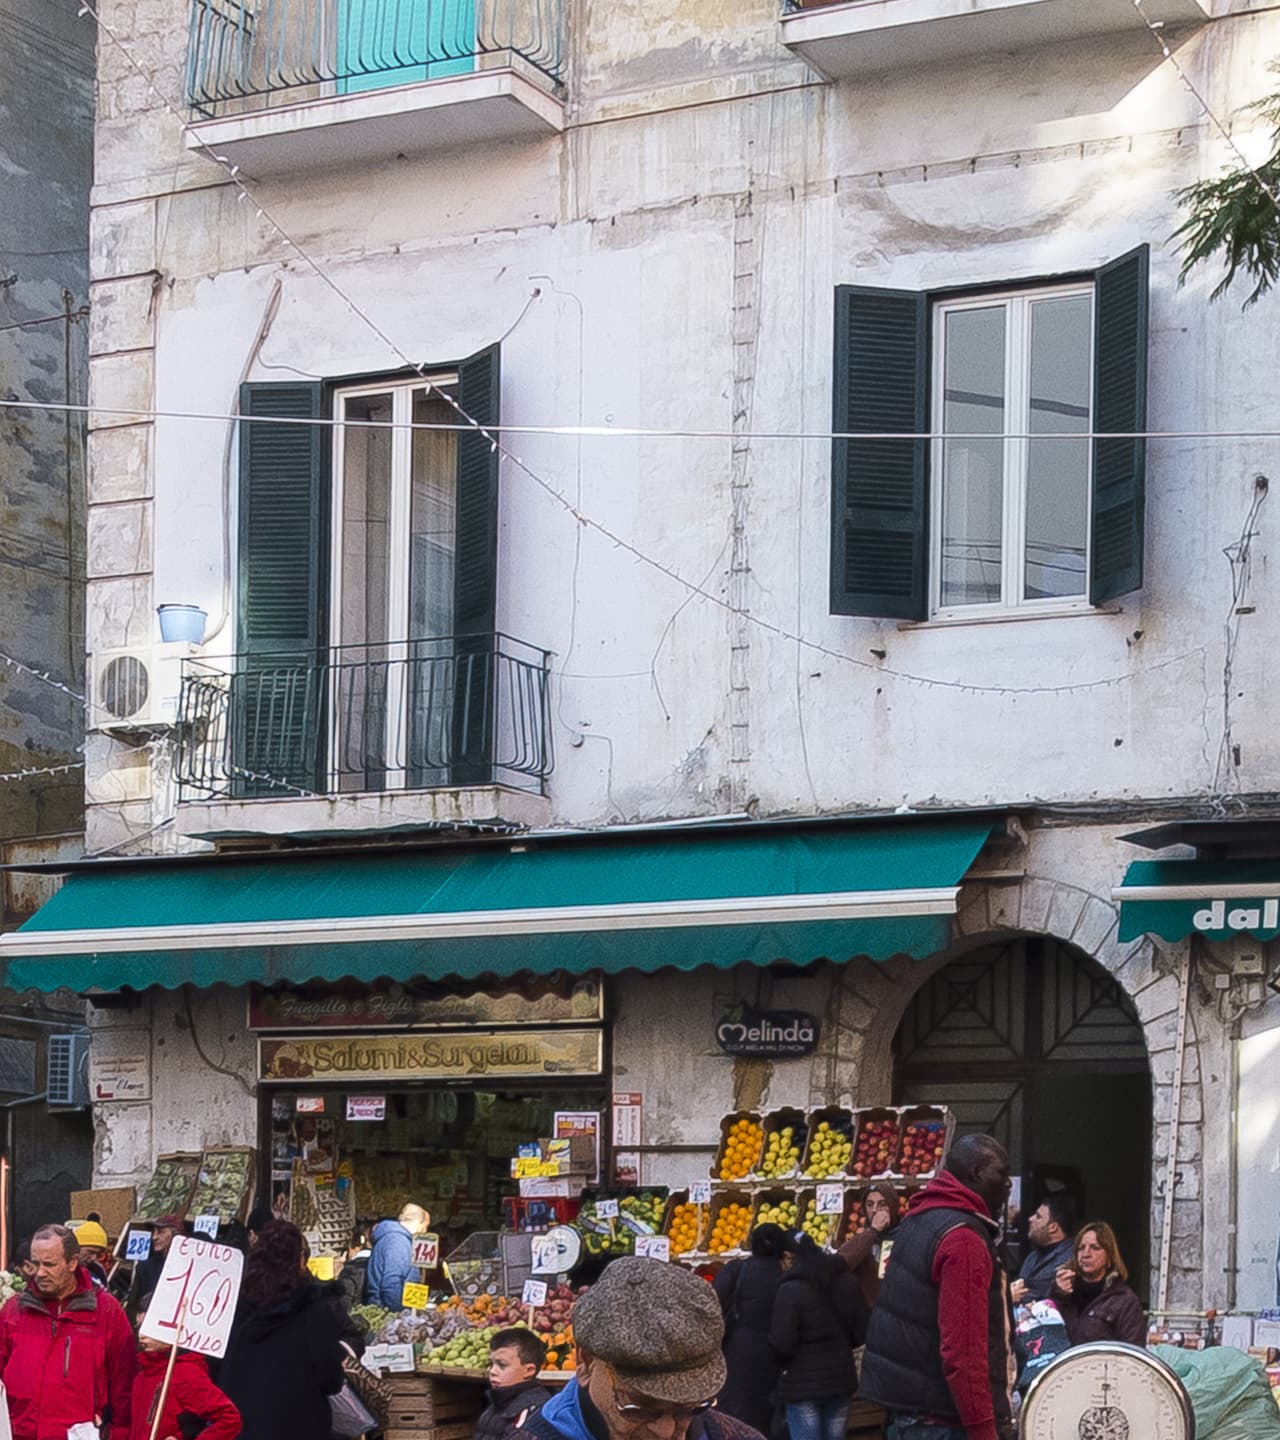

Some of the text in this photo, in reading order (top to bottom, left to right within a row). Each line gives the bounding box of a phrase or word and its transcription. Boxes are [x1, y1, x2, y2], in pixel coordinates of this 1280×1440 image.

[1192, 898, 1277, 931] dal
[718, 1019, 814, 1042] Melinda
[179, 1237, 233, 1263] EURO
[158, 1258, 232, 1329] 160
